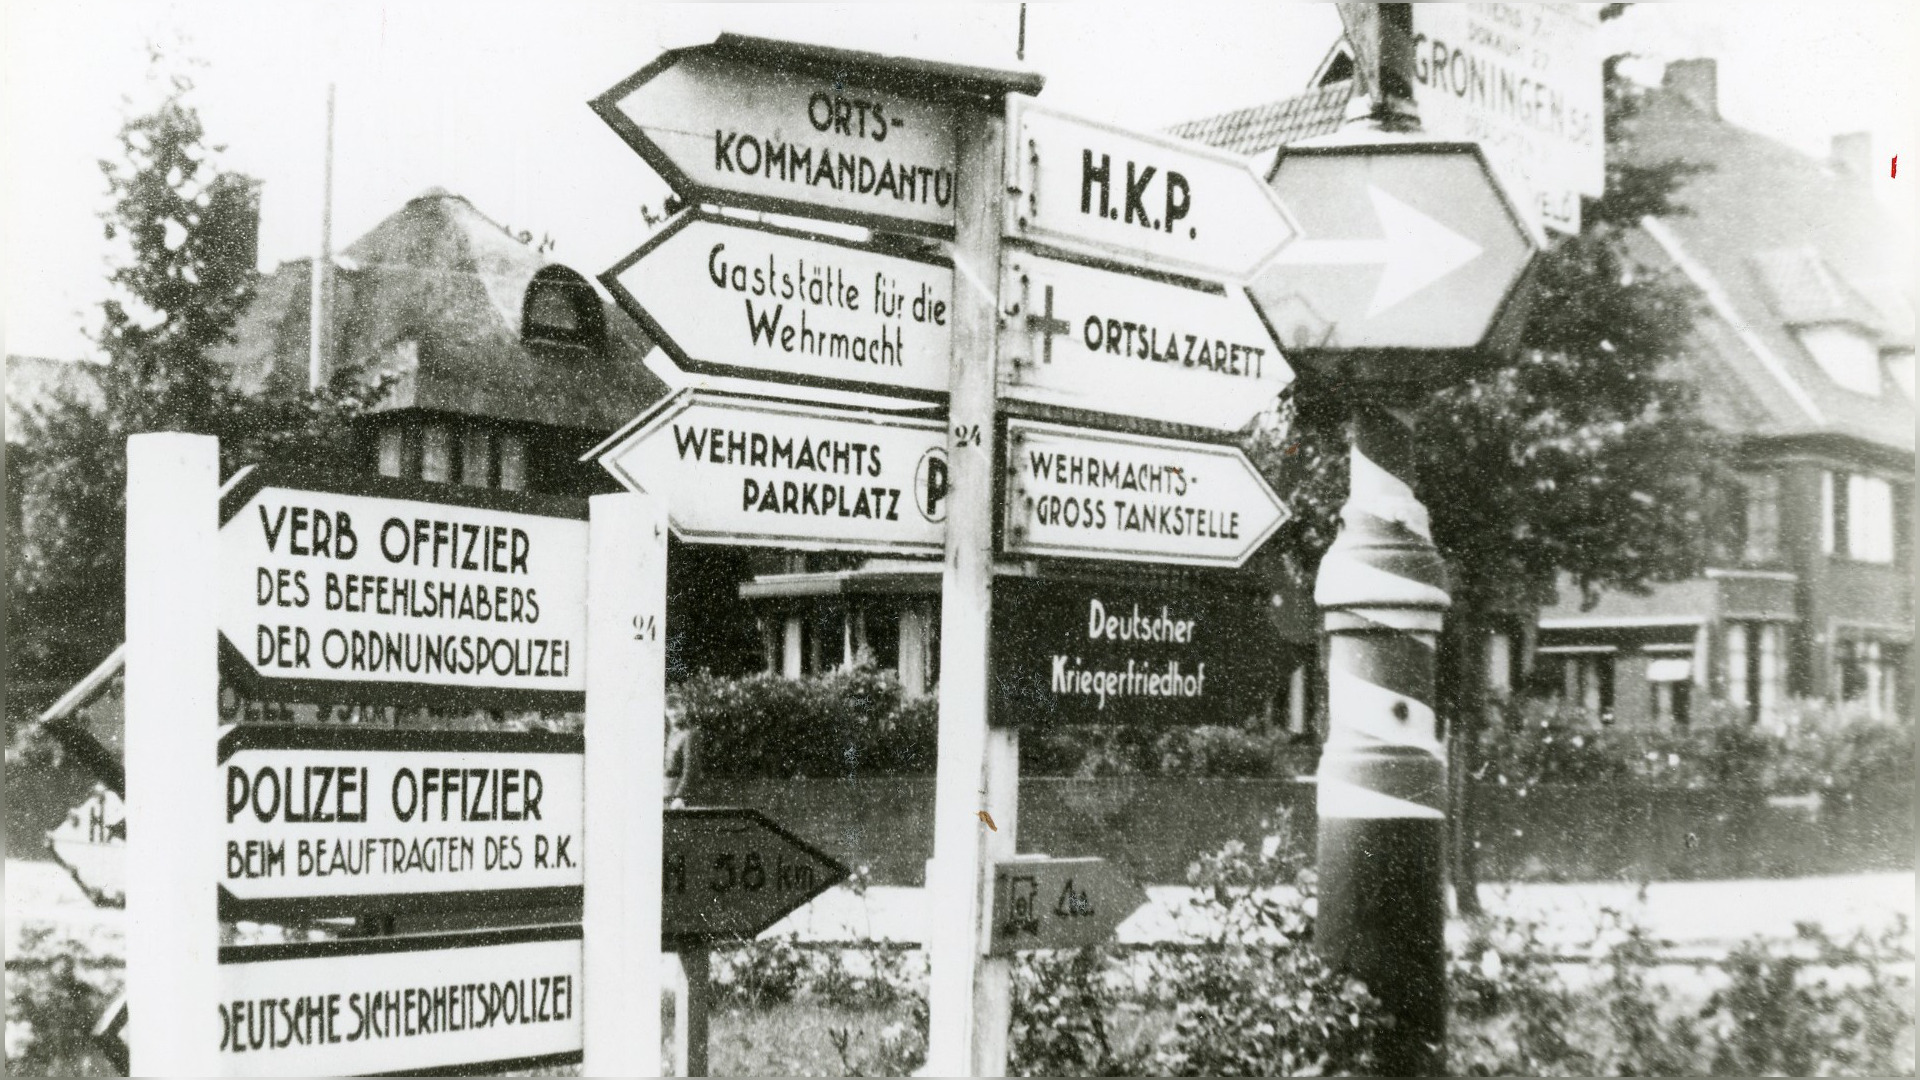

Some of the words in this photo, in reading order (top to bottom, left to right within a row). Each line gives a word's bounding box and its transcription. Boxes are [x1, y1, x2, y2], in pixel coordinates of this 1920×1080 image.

[1413, 32, 1565, 136] GRONINGEN
[808, 91, 904, 142] ORTS-
[1081, 149, 1196, 240] H.K.P.
[709, 243, 859, 312] Gaststätte
[874, 272, 904, 317] für
[911, 282, 947, 326] die
[745, 299, 904, 367] Wehrmacht
[1084, 315, 1265, 378] ORTSLAZARETT
[673, 425, 882, 477] WEHRMACHTS
[954, 425, 981, 447] 24
[743, 478, 901, 521] PARKPLATZ
[927, 456, 948, 514] P
[1030, 451, 1198, 497] WEHRMACHTS-
[259, 505, 358, 560] VERB
[380, 517, 530, 574] OFFIZIER
[1037, 495, 1106, 530] GROSS
[1114, 501, 1239, 539] TANKSTELLE
[257, 566, 310, 607] DES
[325, 572, 540, 623] BEFEHLSHABERS
[1089, 599, 1195, 643] Deutscher
[257, 624, 311, 668] DER
[322, 628, 570, 677] ORDNUNGSPOLIZEI
[632, 614, 657, 641] 24
[1051, 654, 1206, 709] Kriegerfriedhof
[226, 766, 368, 823] POLIZEI
[392, 767, 543, 822] OFFIZIER
[226, 839, 285, 878] BEIM
[297, 836, 474, 876] BEAUFTRAGTEN
[485, 834, 523, 871] DES
[535, 834, 577, 869] R.K.
[347, 975, 572, 1042] SICHERHEITSPOLIZEI
